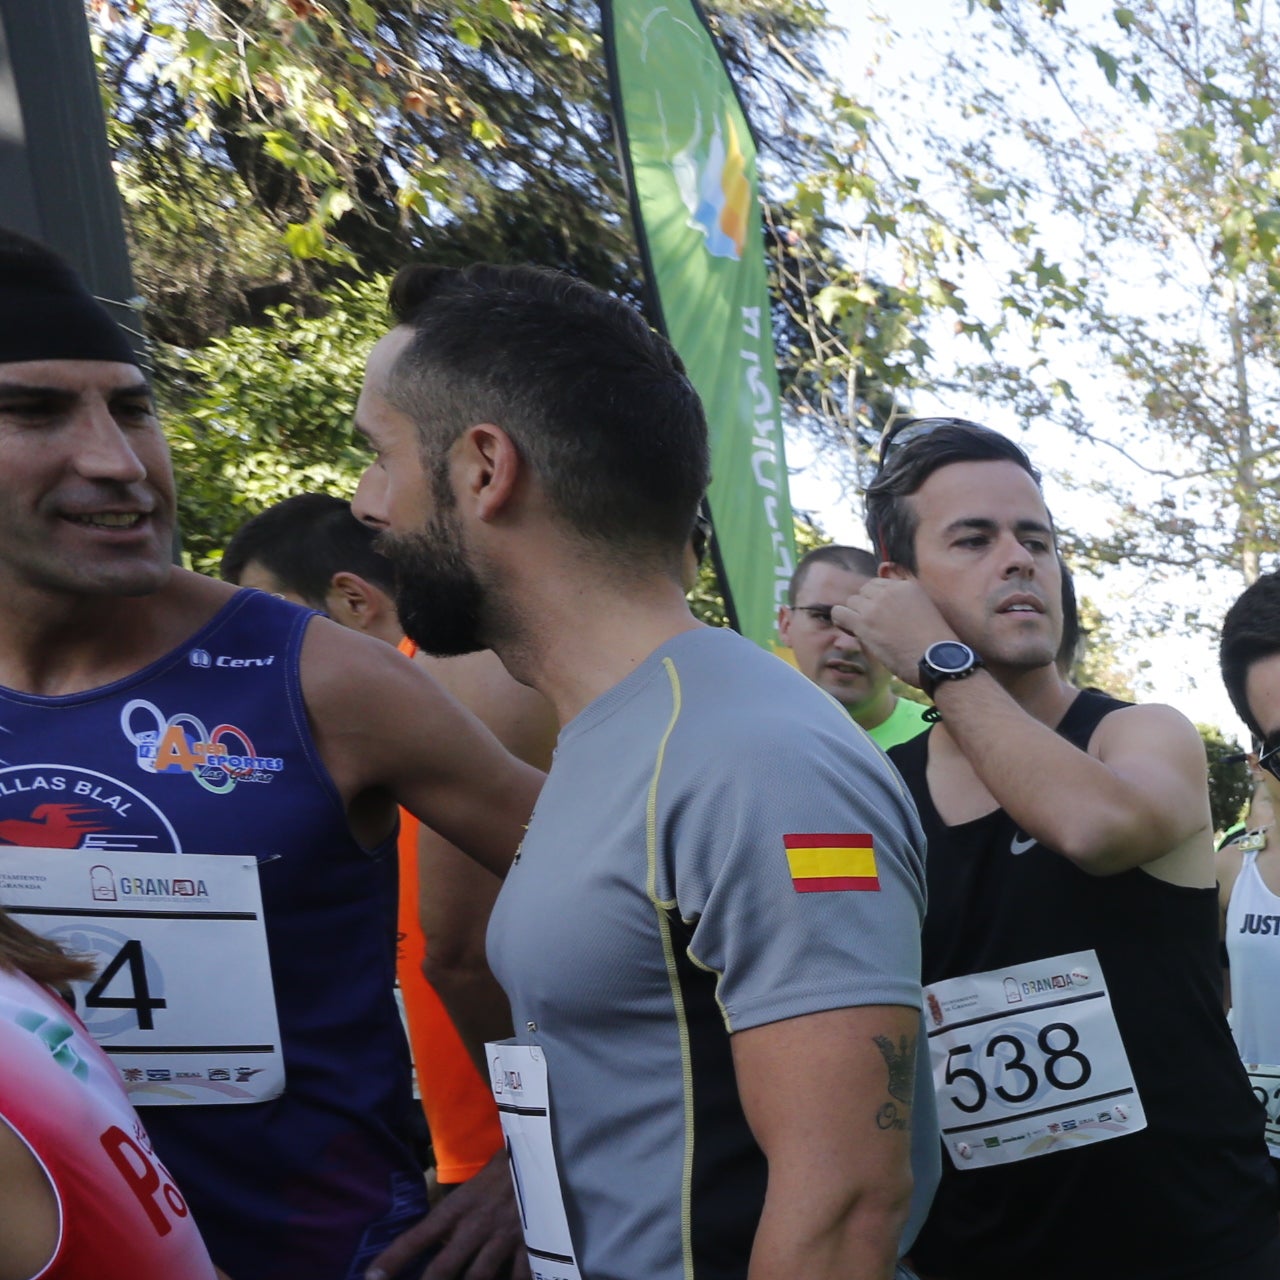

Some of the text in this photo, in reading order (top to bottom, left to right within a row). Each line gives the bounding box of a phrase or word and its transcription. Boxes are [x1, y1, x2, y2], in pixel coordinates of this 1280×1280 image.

[215, 655, 275, 668] Cervi
[121, 877, 208, 897] GRANADA
[1022, 973, 1073, 995] GRANADA
[945, 1022, 1092, 1114] 538
